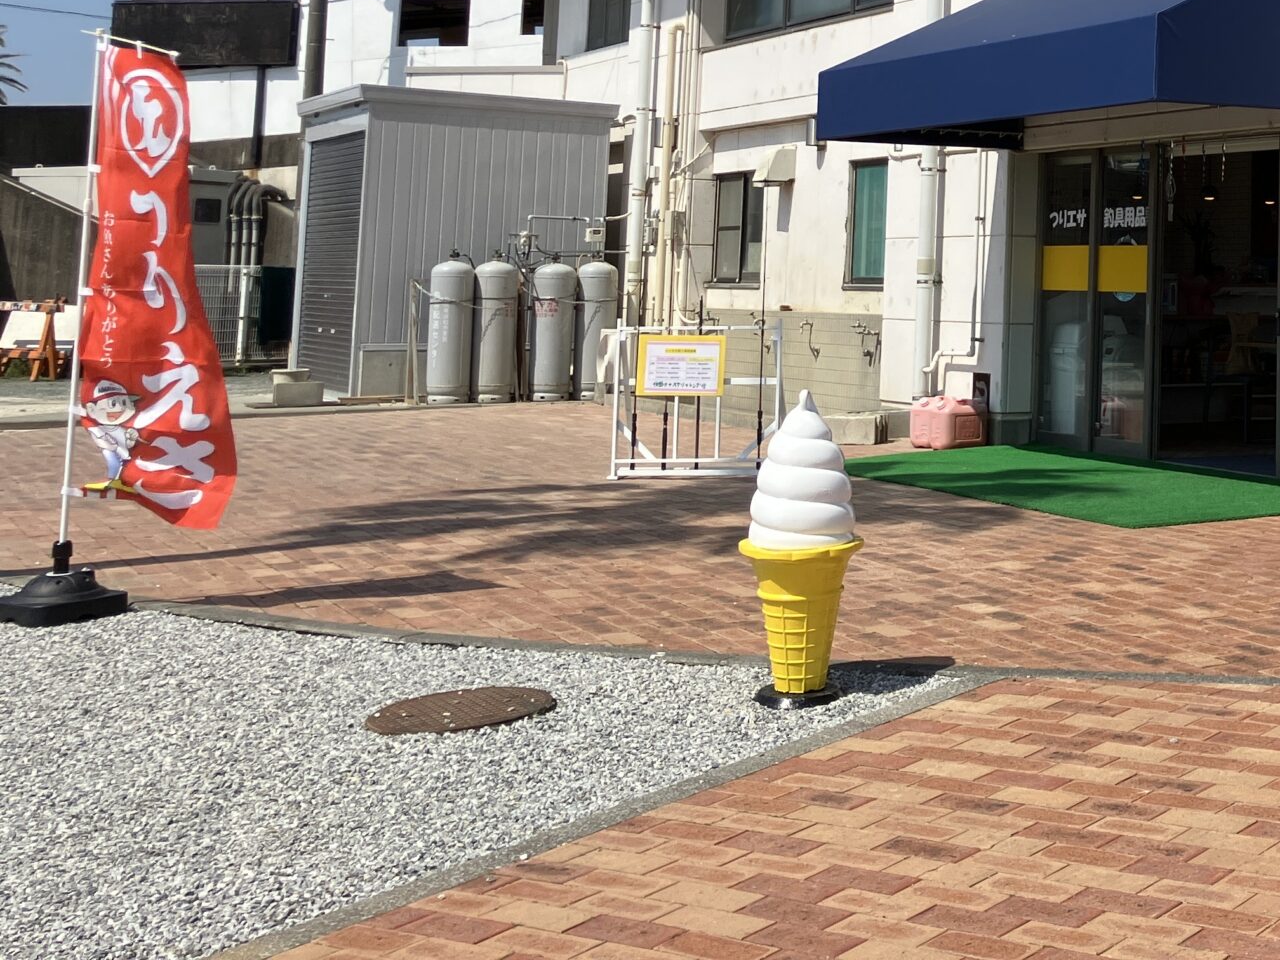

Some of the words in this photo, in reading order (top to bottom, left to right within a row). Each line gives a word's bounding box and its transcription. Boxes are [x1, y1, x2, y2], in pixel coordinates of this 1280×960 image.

[1049, 208, 1087, 229] つりエサ
[1103, 206, 1147, 228] 釣具用品
[130, 190, 216, 512] つりえさ
